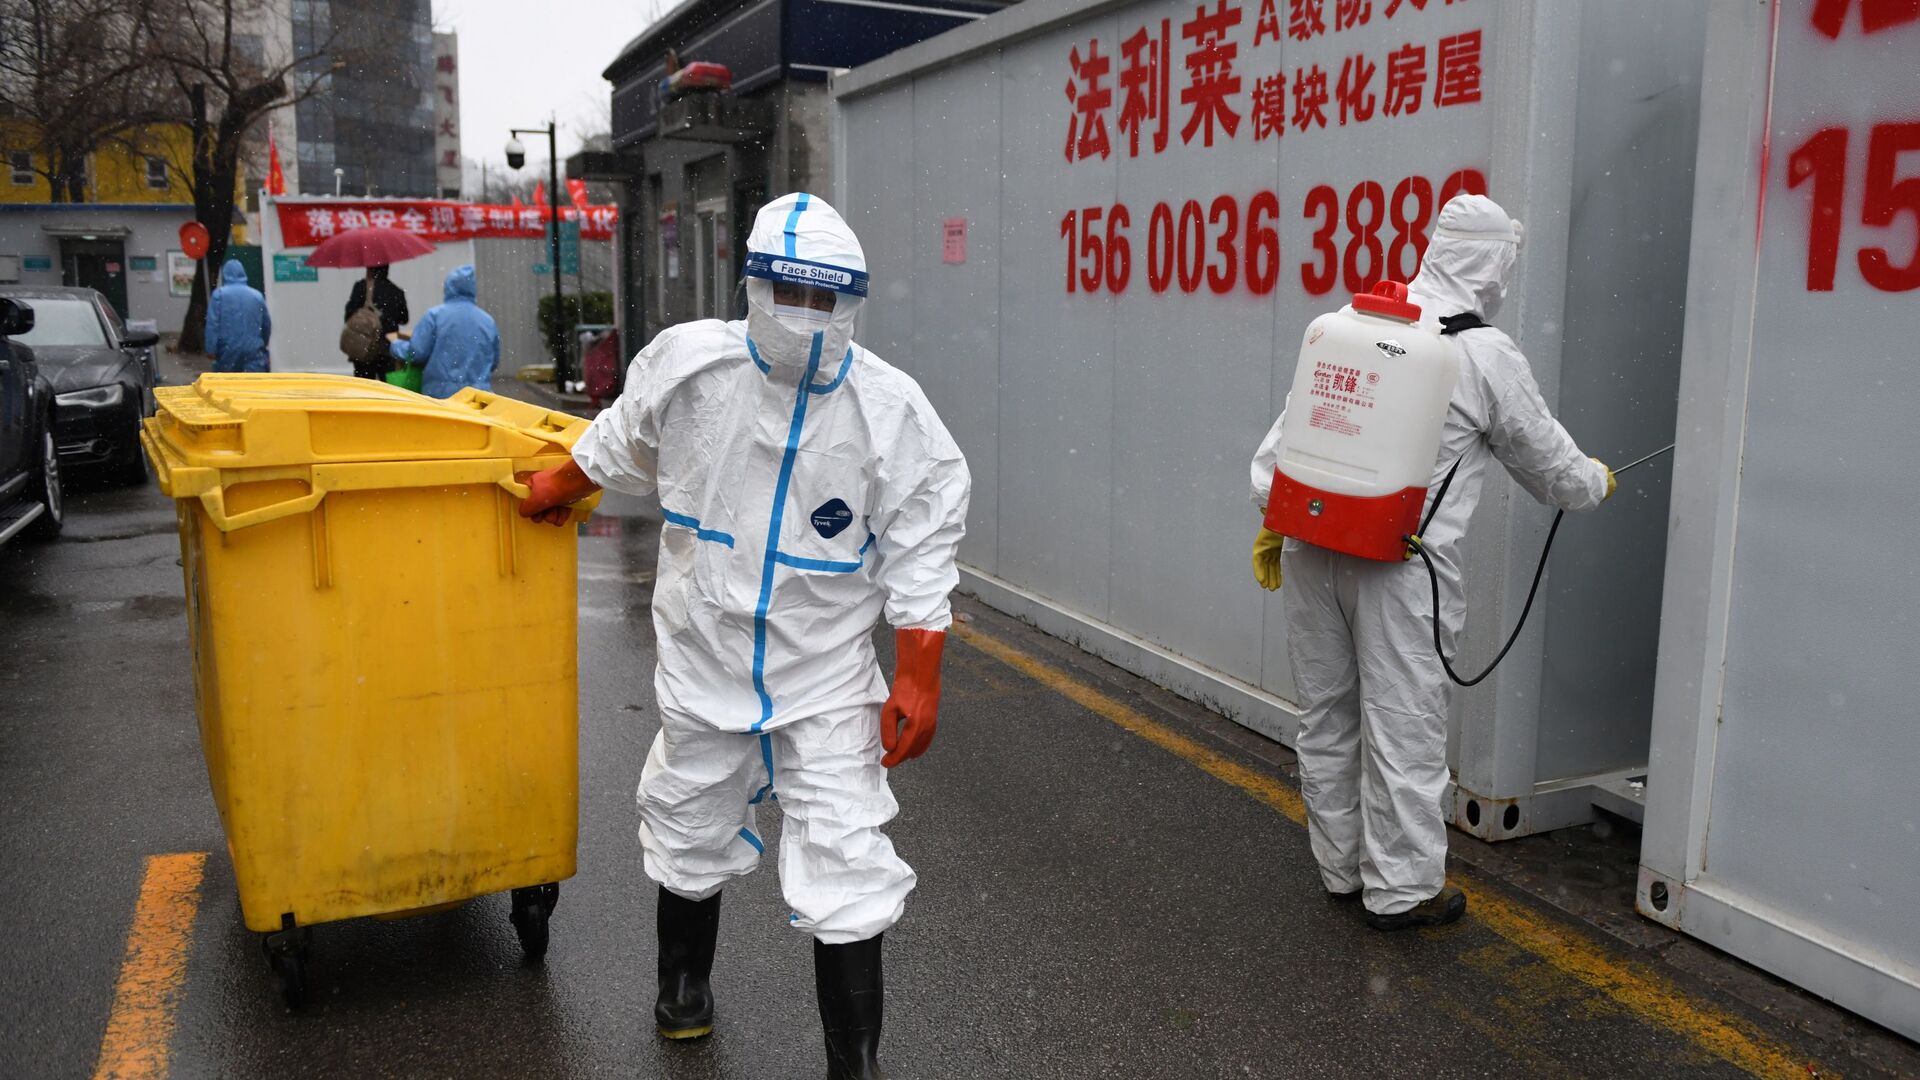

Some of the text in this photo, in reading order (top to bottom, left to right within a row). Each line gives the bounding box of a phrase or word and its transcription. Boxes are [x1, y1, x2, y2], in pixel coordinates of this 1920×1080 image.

[1065, 0, 1242, 164] 法利莱
[1251, 29, 1483, 142] 模块化房屋
[781, 263, 807, 276] Face
[810, 268, 844, 283] Shield
[782, 275, 840, 290] Direct Splash Protection
[1060, 169, 1487, 296] 156 0036 388
